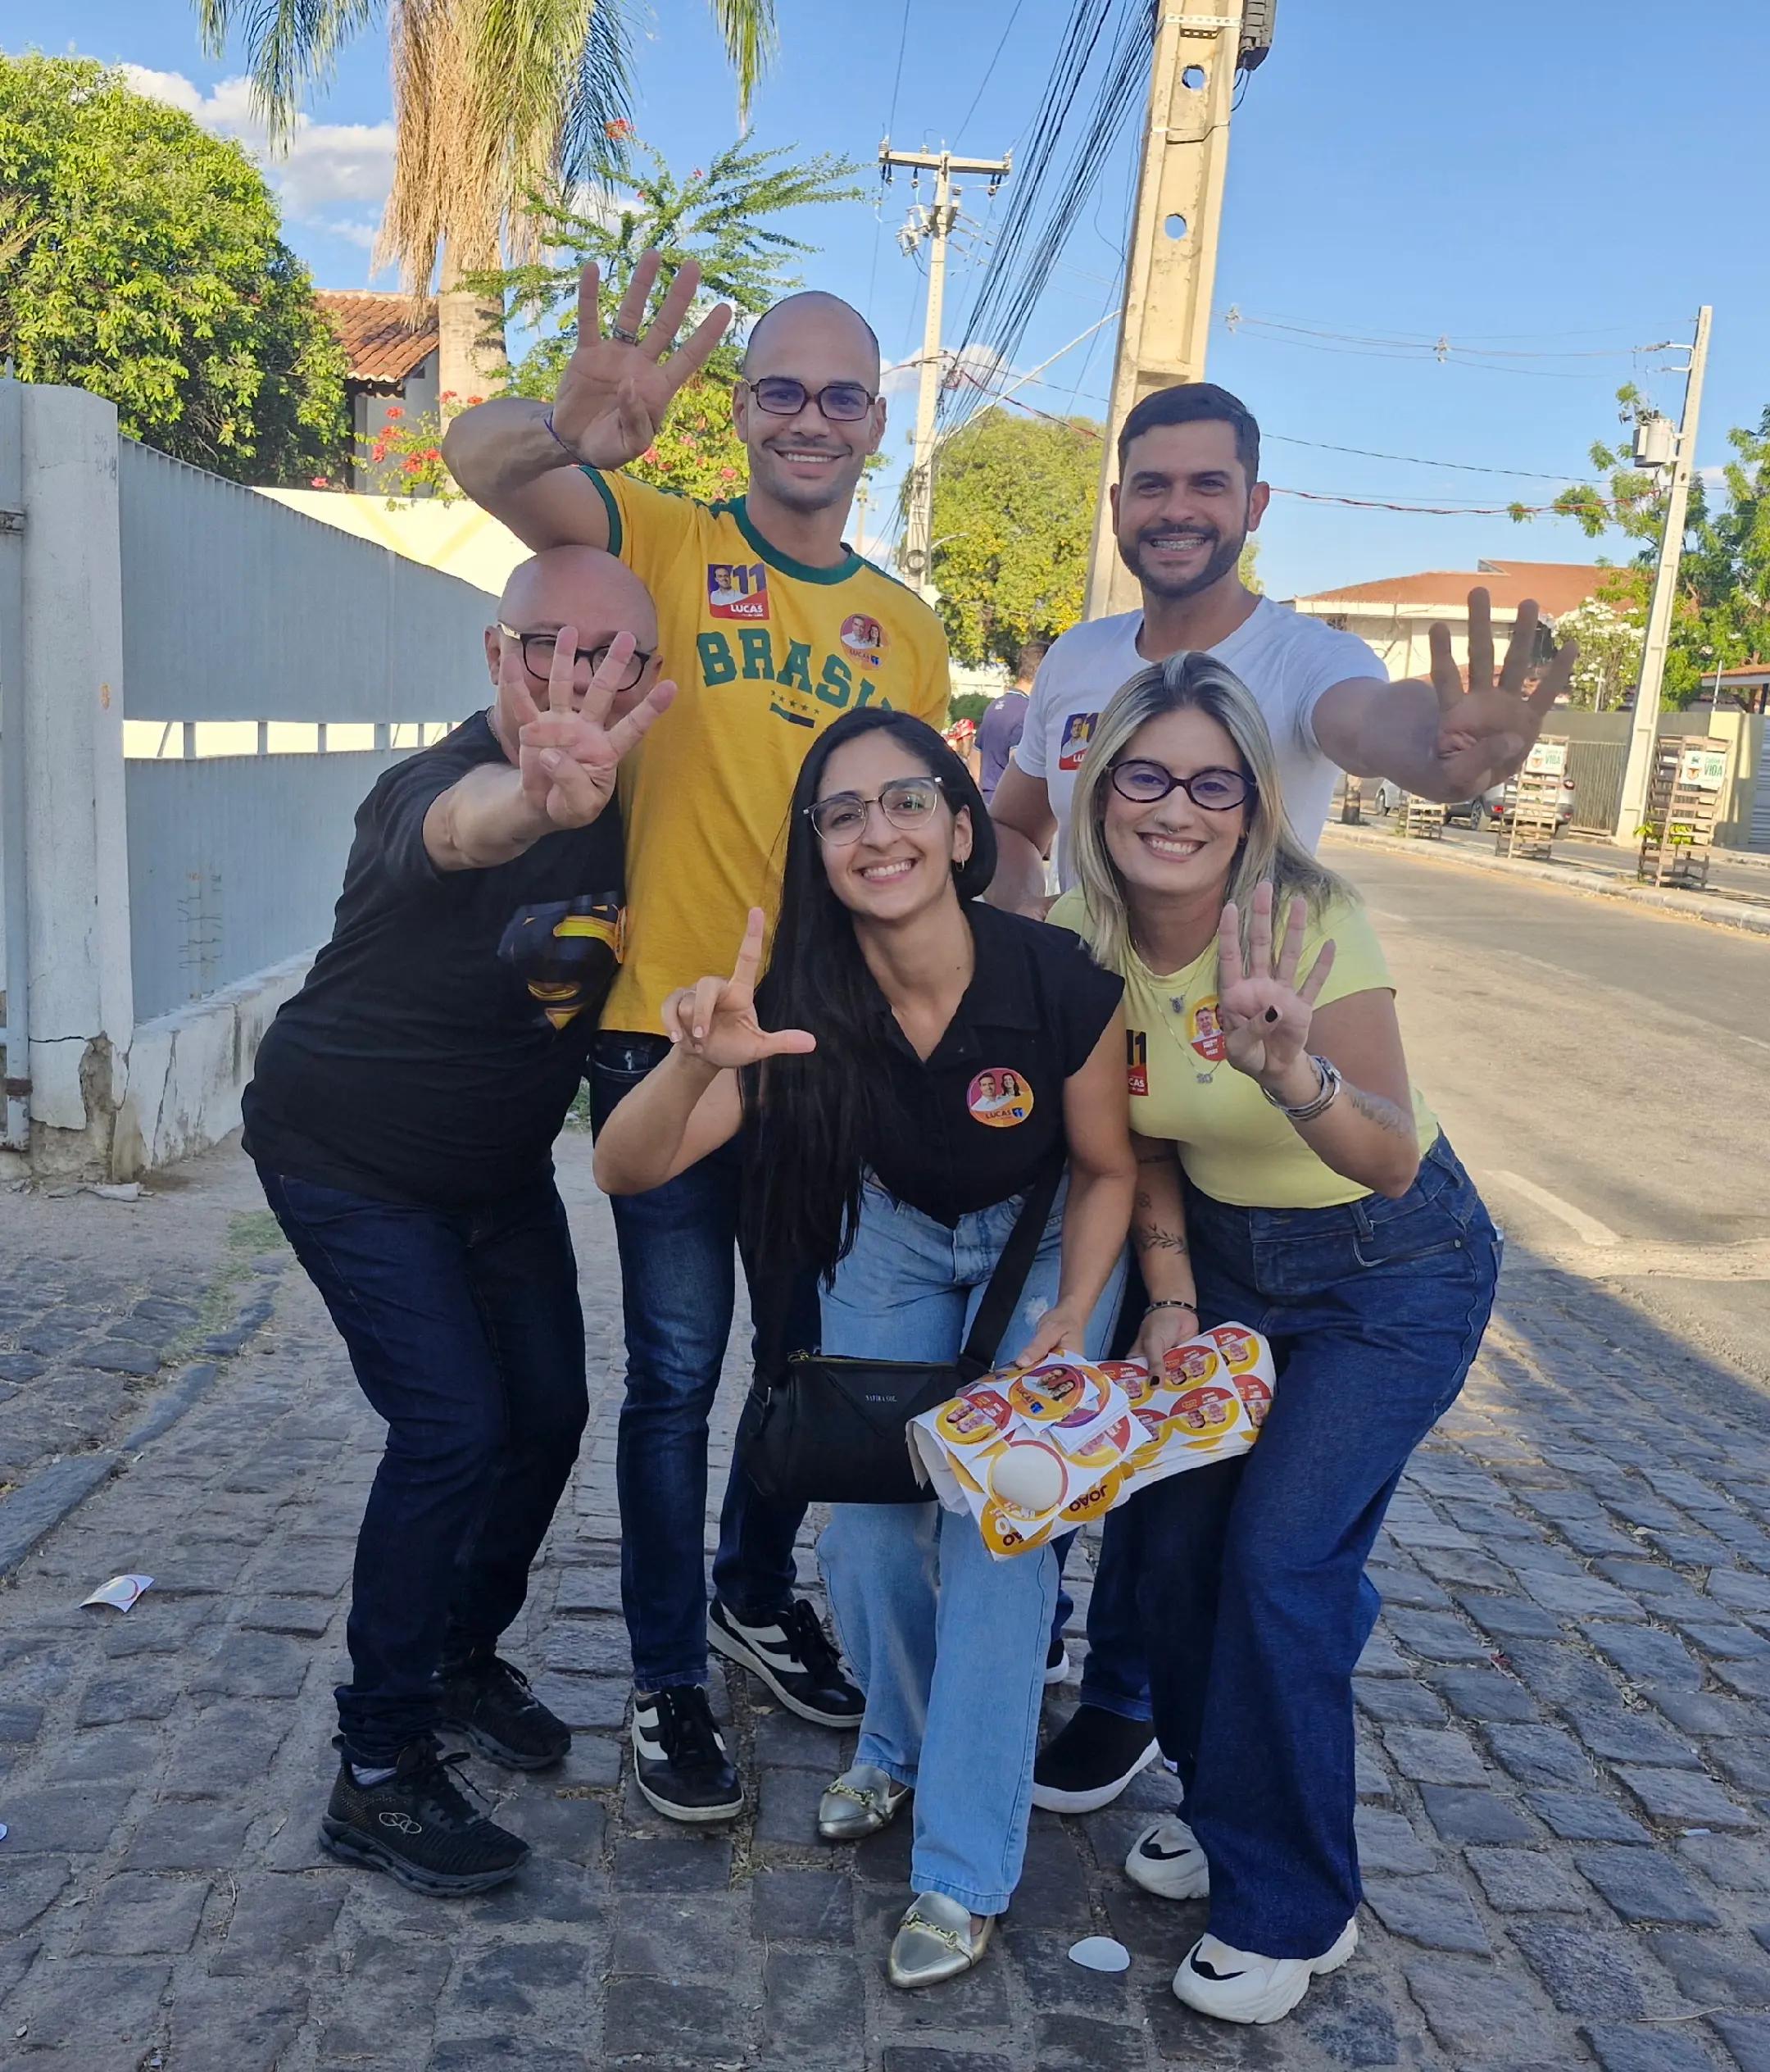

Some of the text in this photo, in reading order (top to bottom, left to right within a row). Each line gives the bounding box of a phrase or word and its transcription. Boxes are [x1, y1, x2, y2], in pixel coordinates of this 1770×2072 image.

[733, 563, 767, 594] 11
[730, 604, 764, 613] LUCAS
[697, 628, 892, 710] BRASI
[1704, 764, 1722, 777] VIDA
[1128, 1077, 1146, 1088] CAS
[986, 1109, 1012, 1120] LUCAS
[1069, 1484, 1108, 1511] JOÃO
